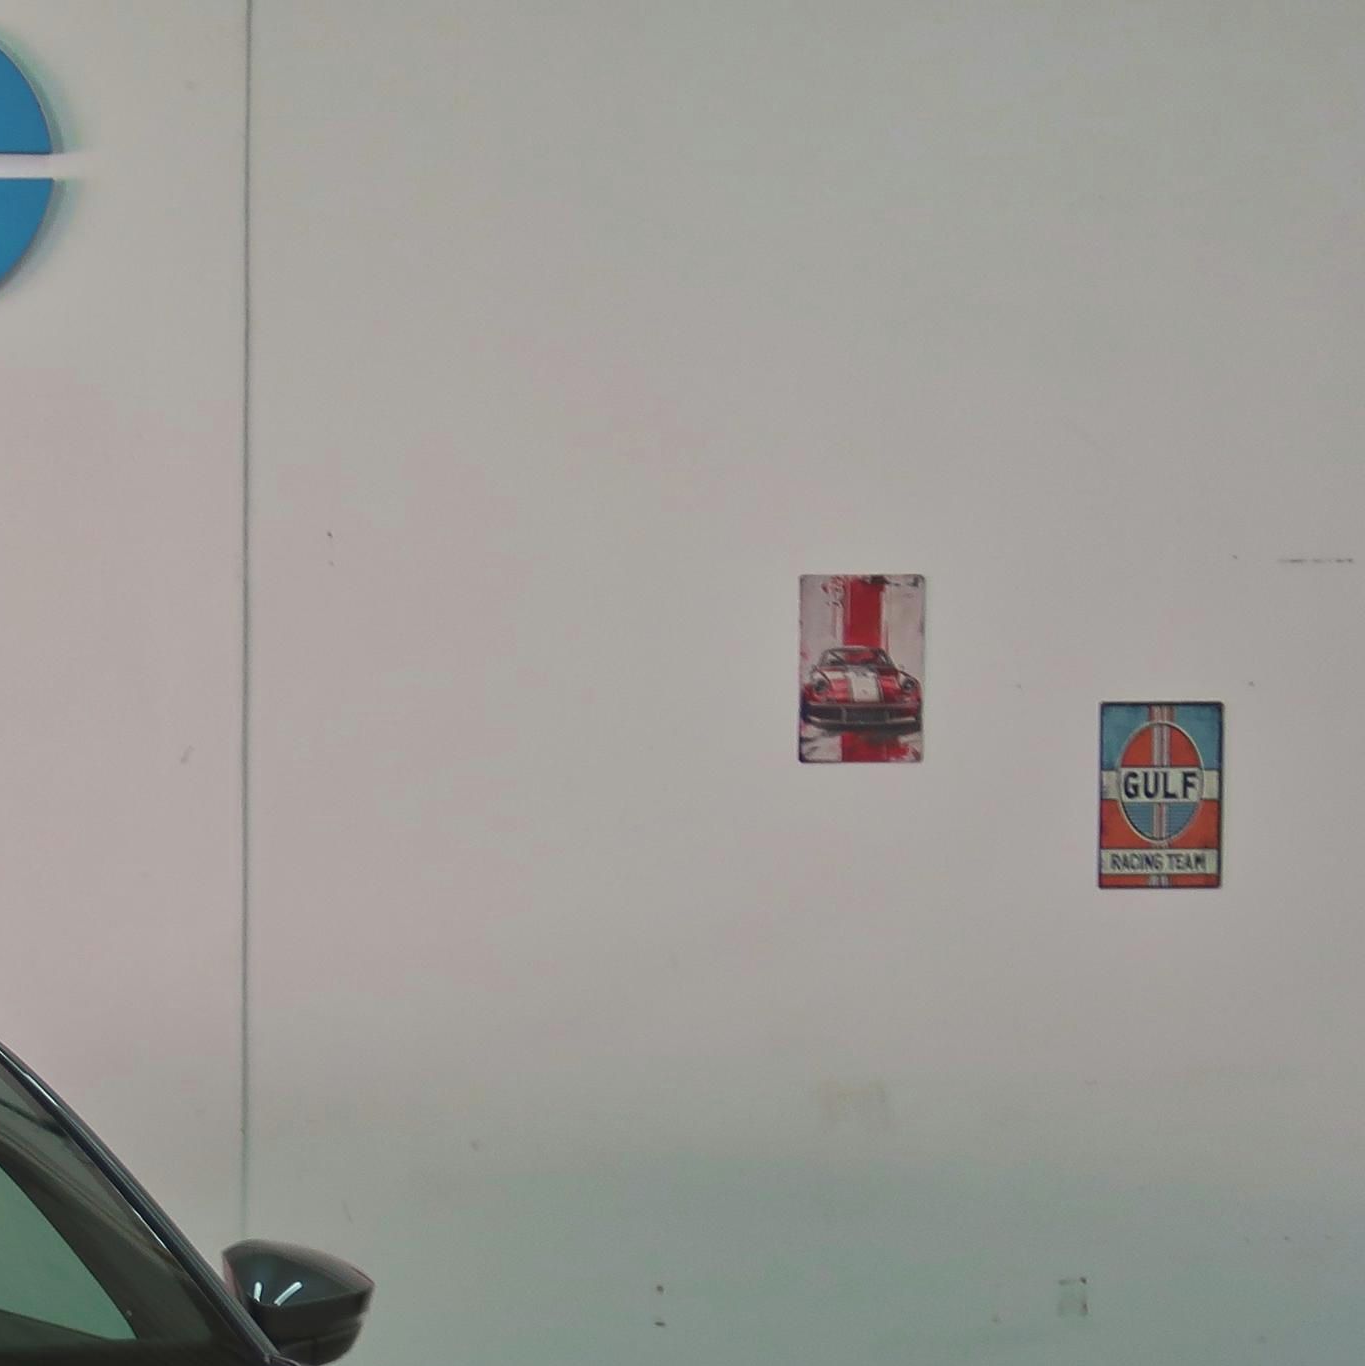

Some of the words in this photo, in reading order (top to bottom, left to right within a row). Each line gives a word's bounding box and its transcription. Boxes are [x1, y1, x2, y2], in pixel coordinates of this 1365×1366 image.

[1124, 771, 1197, 799] GULF
[1110, 853, 1163, 871] RACING
[1167, 853, 1207, 871] TEAM
